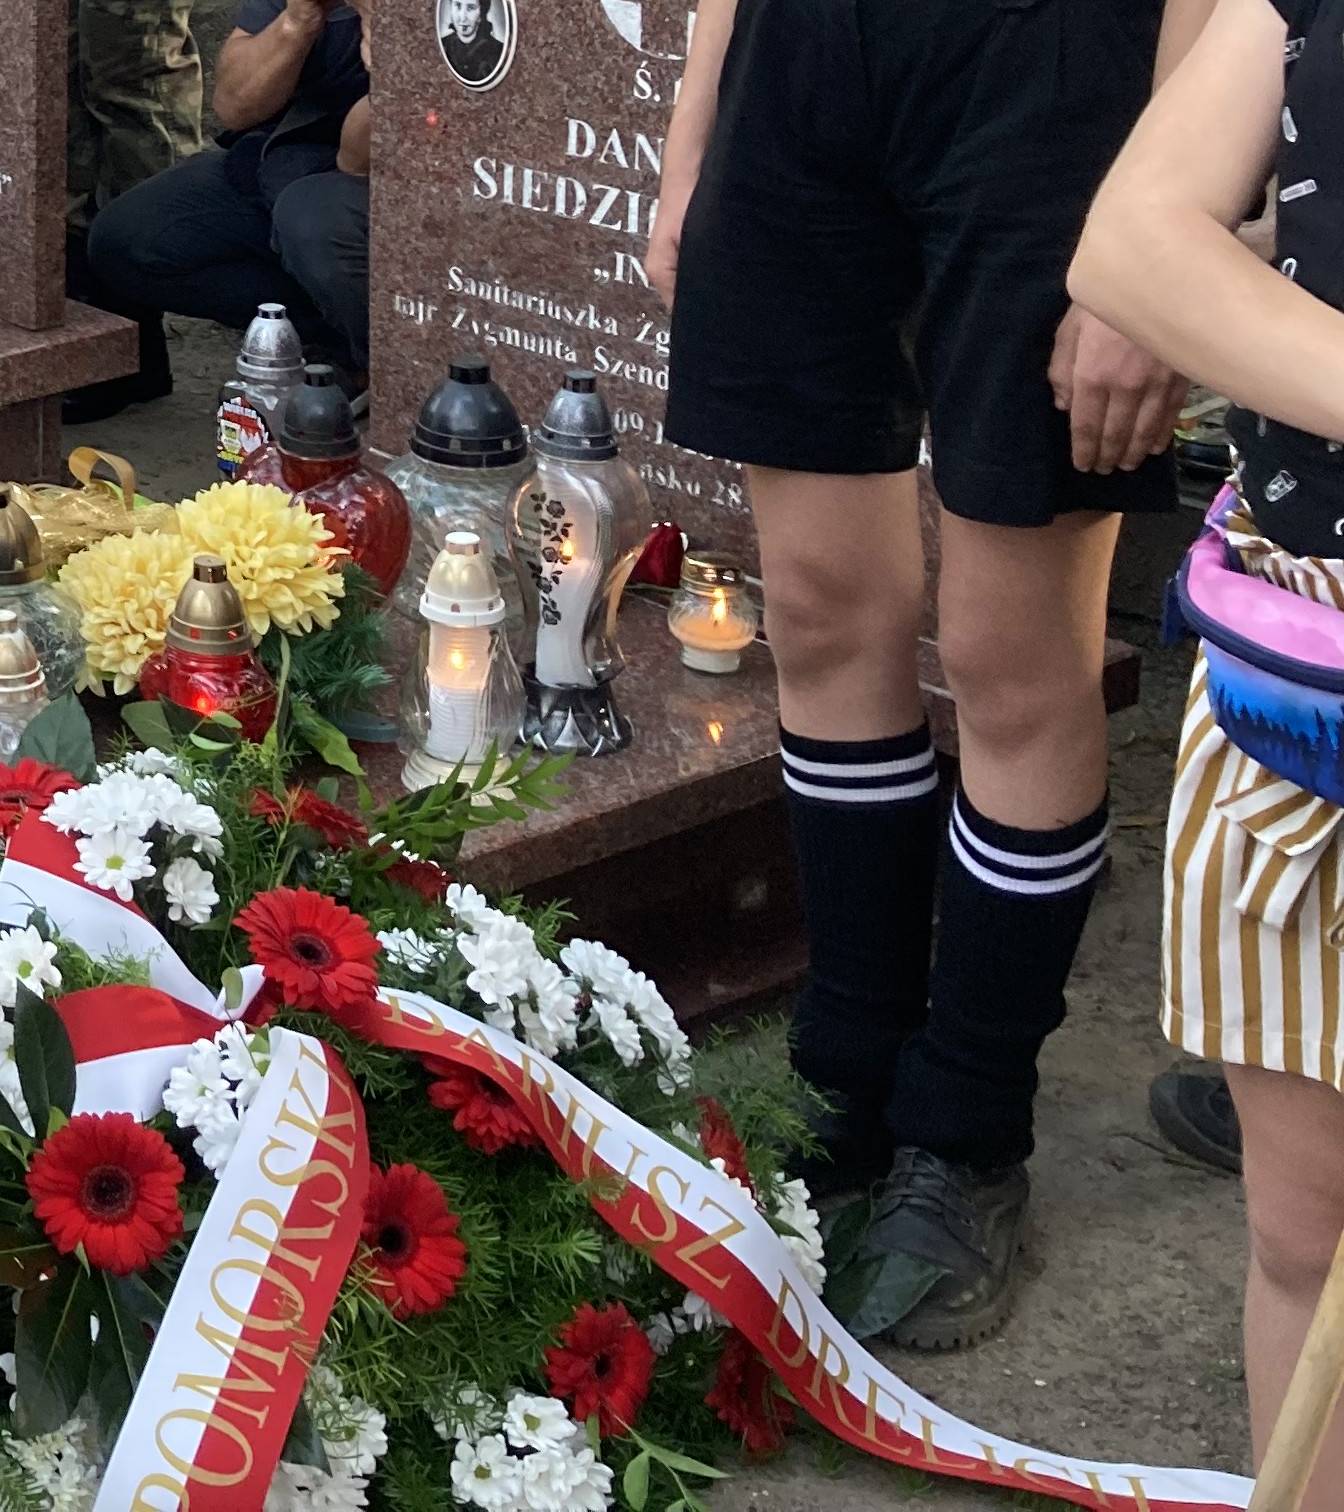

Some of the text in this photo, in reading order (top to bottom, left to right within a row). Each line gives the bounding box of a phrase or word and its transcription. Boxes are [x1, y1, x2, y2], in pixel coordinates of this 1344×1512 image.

[564, 116, 665, 177] DAN
[448, 266, 618, 336] Sanitariuszka
[450, 307, 577, 363] Zygmunta
[594, 345, 670, 390] Szend
[383, 995, 746, 1289] DARIUSZ
